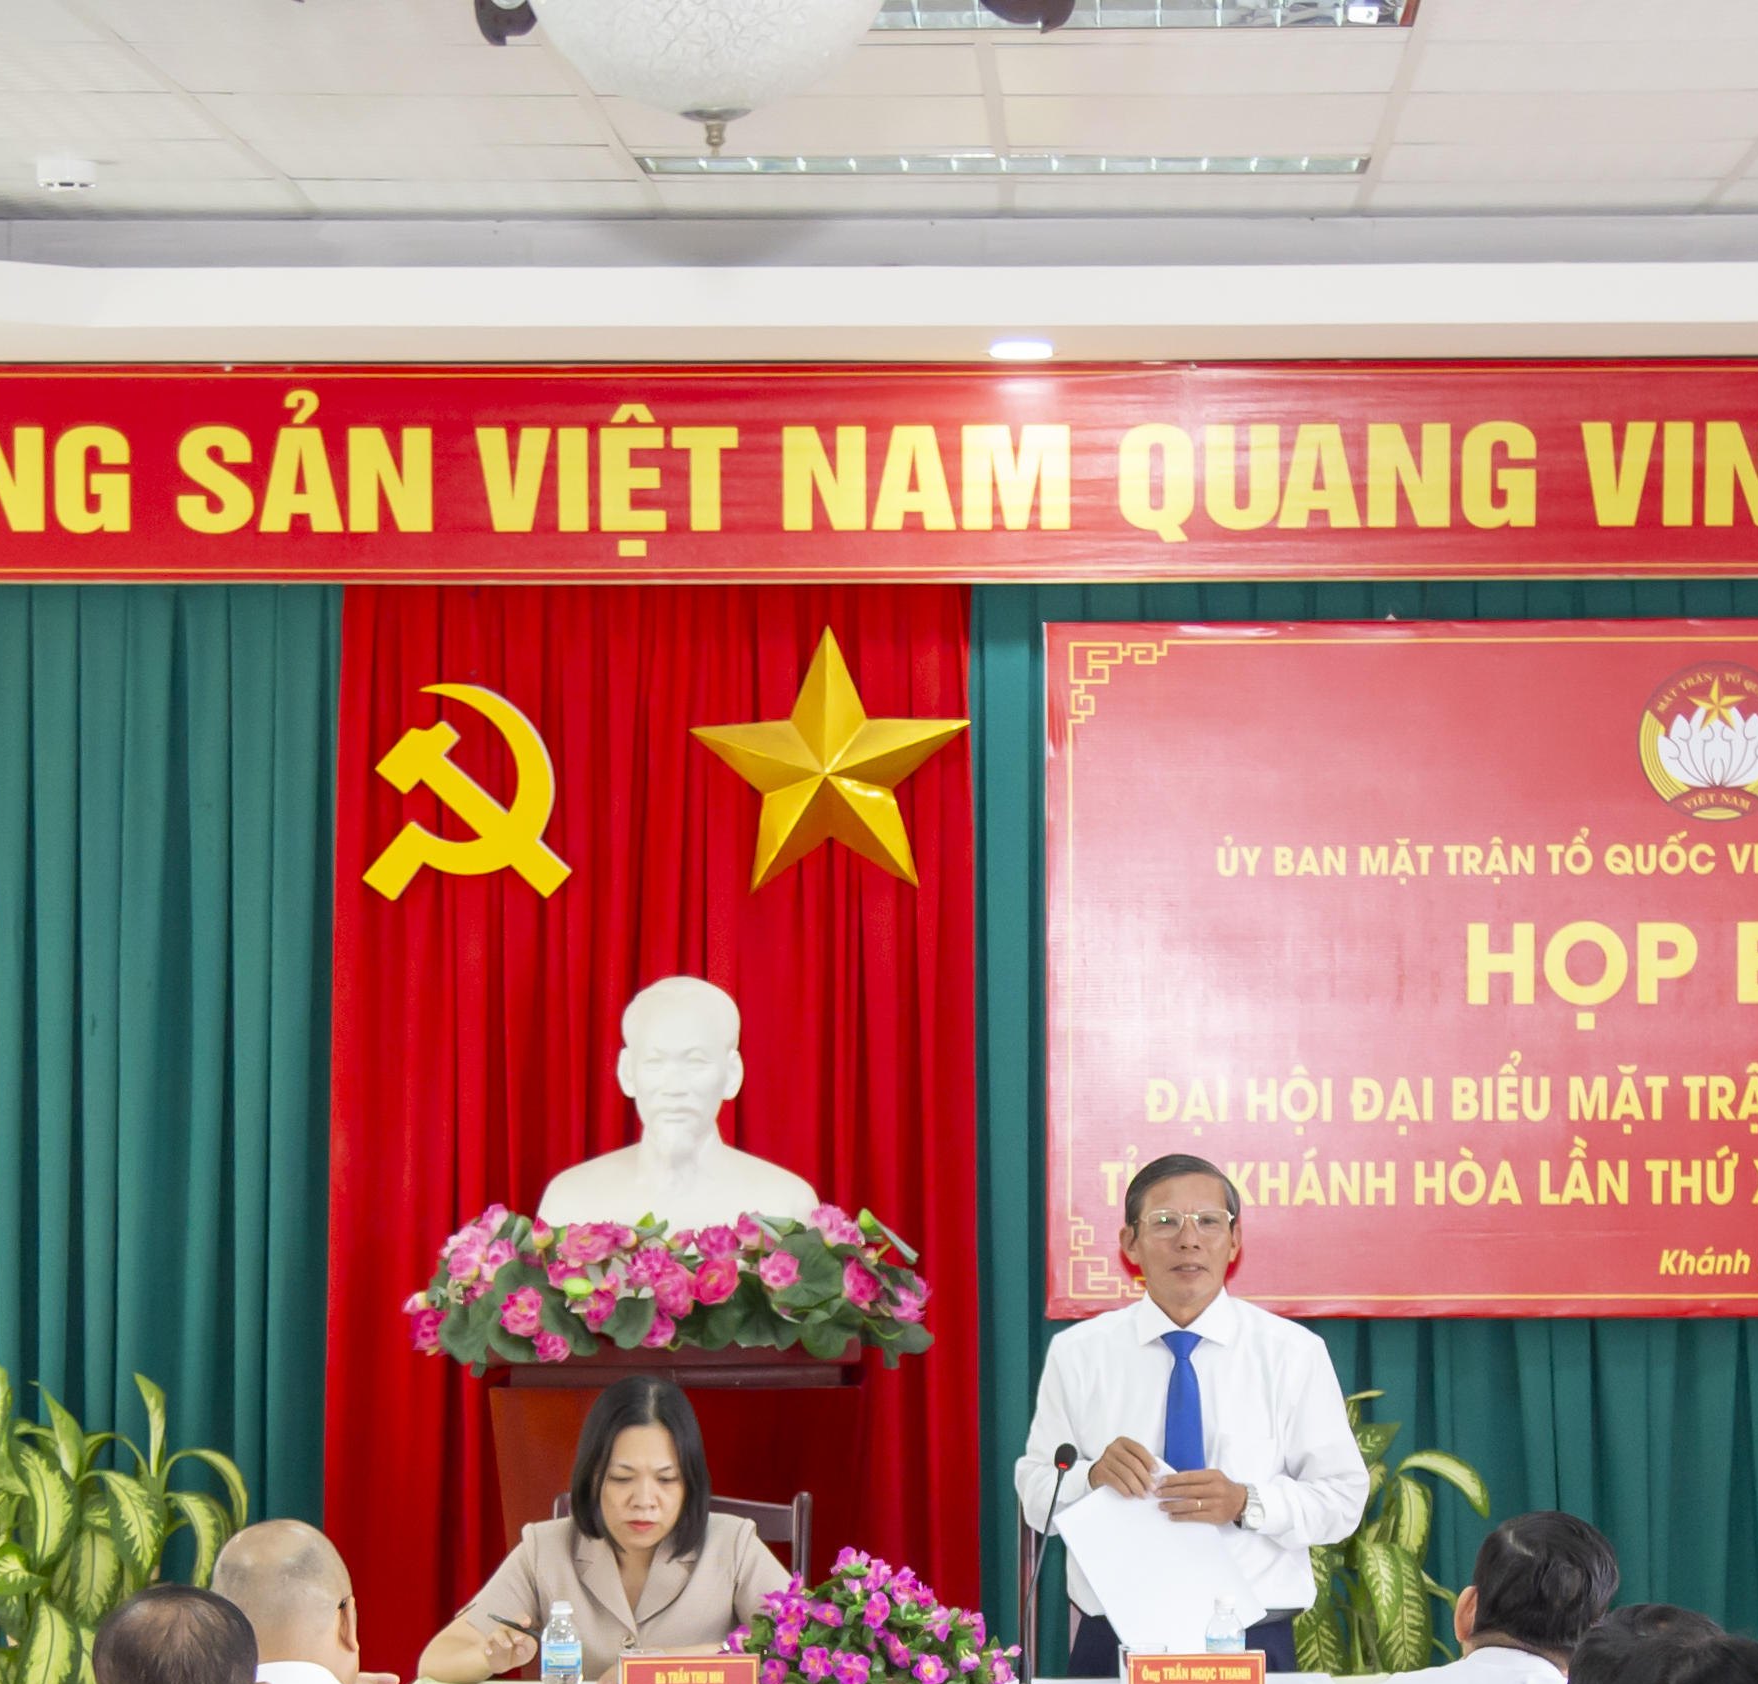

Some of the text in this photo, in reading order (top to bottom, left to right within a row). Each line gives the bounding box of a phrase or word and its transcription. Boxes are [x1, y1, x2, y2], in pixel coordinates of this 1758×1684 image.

[177, 390, 433, 534] SẢN
[477, 404, 739, 556] VIỆT
[782, 424, 1072, 531] NAM
[1118, 421, 1537, 543] QUANG
[1216, 836, 1261, 877] ỦY
[1274, 846, 1346, 876] BAN
[1359, 838, 1434, 885] MẶT
[1444, 836, 1535, 884] TRẬN
[1547, 827, 1593, 875] TỔ
[1604, 831, 1715, 876] QUỐC
[1466, 920, 1699, 1030] HỌP
[1145, 1079, 1228, 1136] ĐẠI
[1247, 1065, 1333, 1136] HỘI
[1349, 1077, 1434, 1136] ĐẠI
[1452, 1050, 1551, 1122] BIỂU
[1568, 1063, 1670, 1134] MẶT
[1227, 1147, 1396, 1206] KHÁNH
[1414, 1147, 1523, 1206] HÒA
[1540, 1135, 1630, 1206] LẦN
[1645, 1144, 1740, 1206] THỨ
[1659, 1246, 1751, 1276] Khánh
